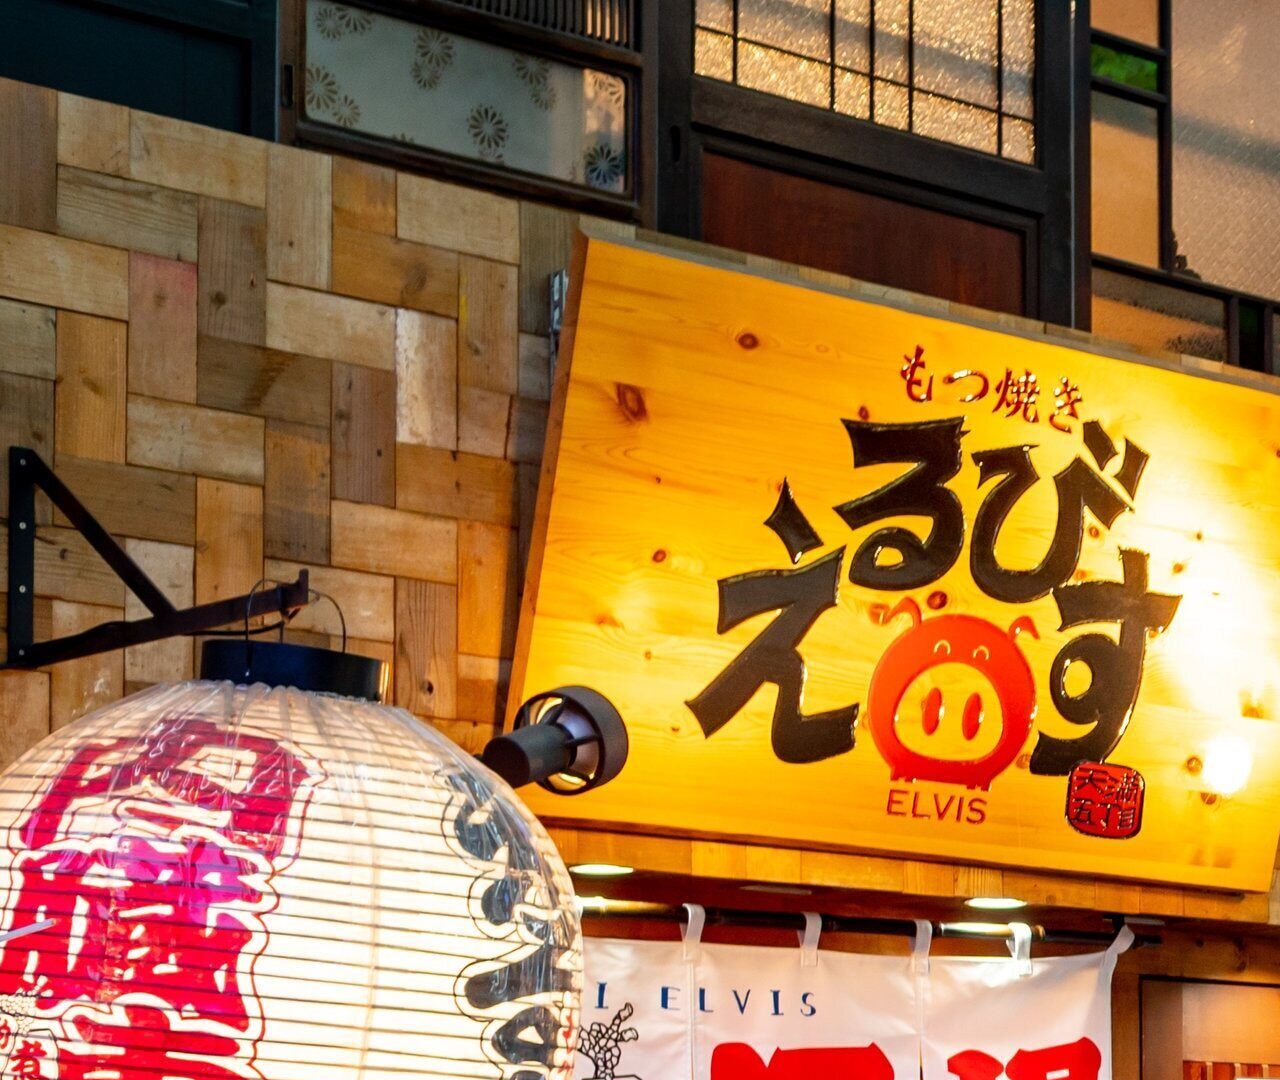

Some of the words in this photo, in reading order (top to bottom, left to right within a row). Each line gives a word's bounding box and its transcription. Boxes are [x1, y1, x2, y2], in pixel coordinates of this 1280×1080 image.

[901, 345, 1083, 432] もつ焼き
[685, 418, 1184, 778] えるびす
[886, 788, 989, 825] ELVIS
[660, 985, 818, 1019] ELVIS
